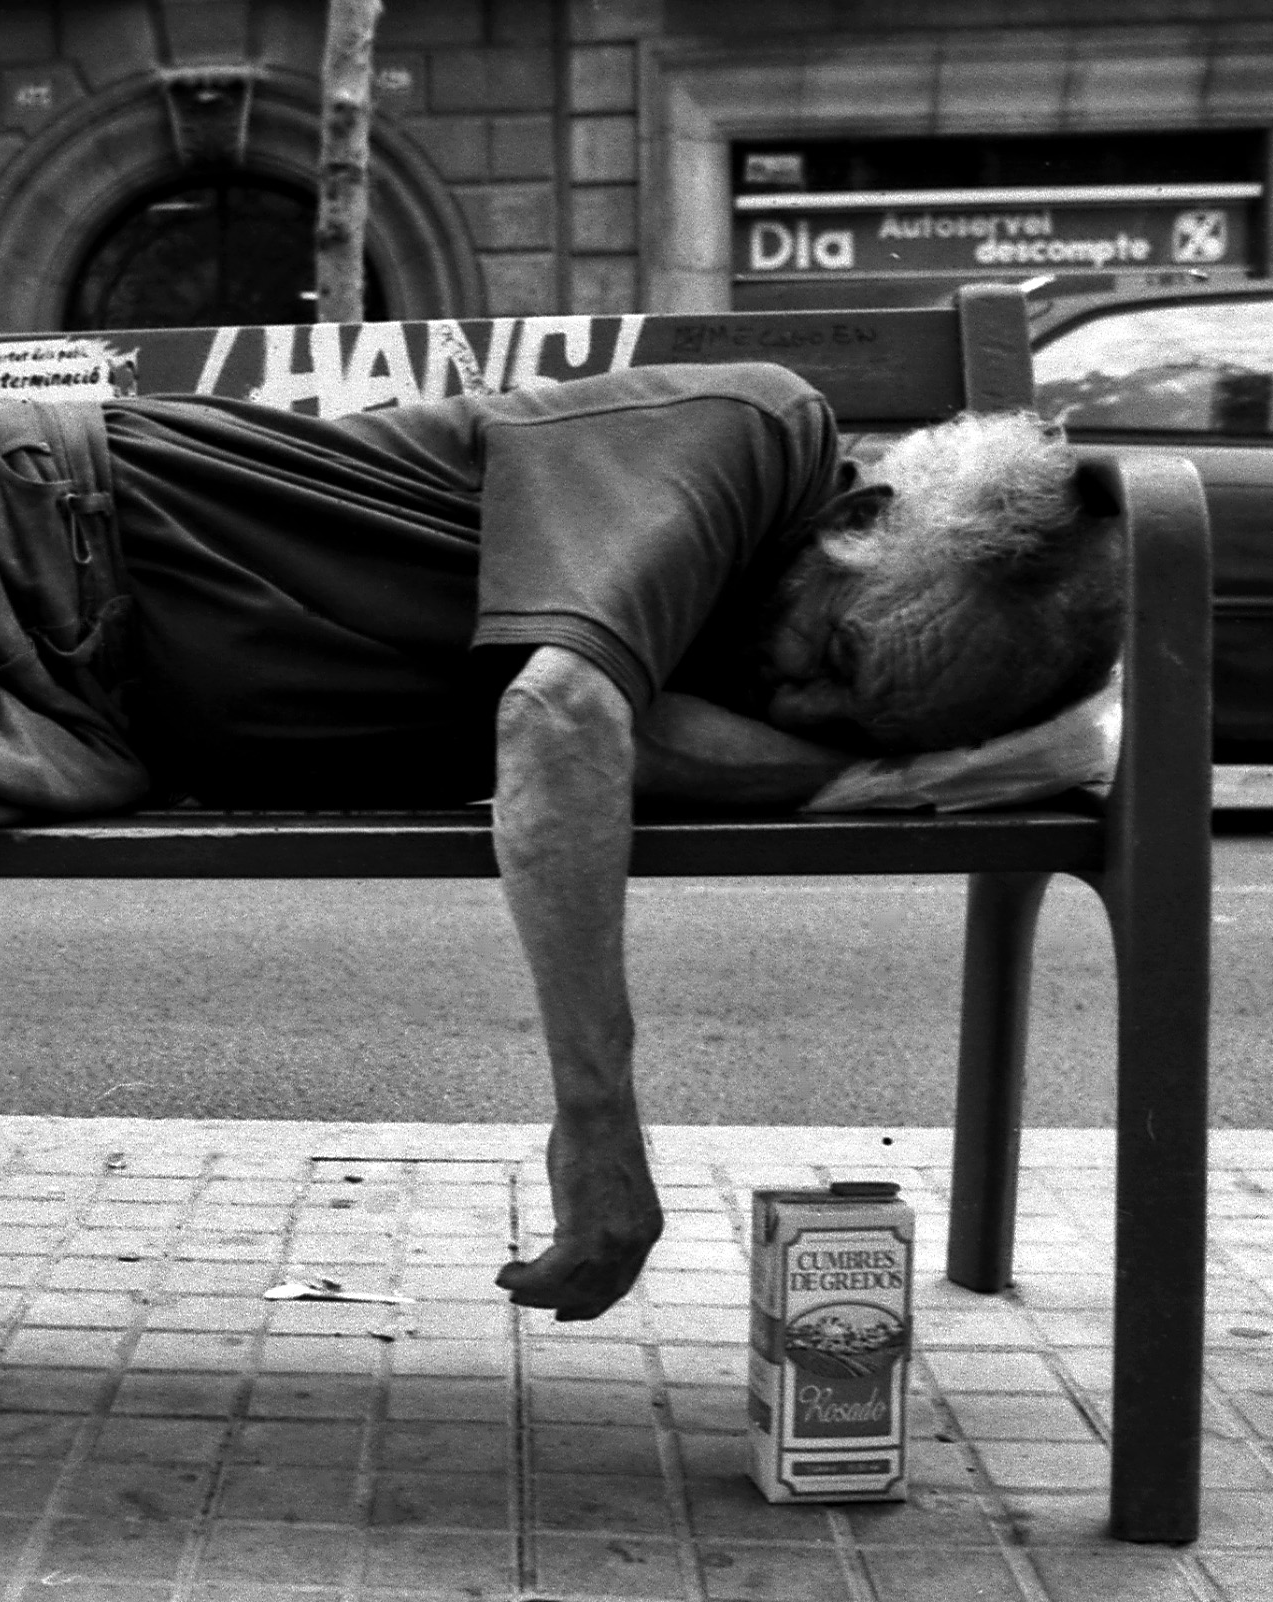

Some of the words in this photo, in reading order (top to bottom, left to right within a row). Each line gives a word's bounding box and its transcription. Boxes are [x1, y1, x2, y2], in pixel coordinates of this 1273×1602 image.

[974, 233, 1151, 268] descompte
[797, 1250, 896, 1271] CUMBRES
[790, 1272, 817, 1291] DE
[819, 1271, 903, 1291] GREDOS
[798, 1384, 887, 1422] Rosado
